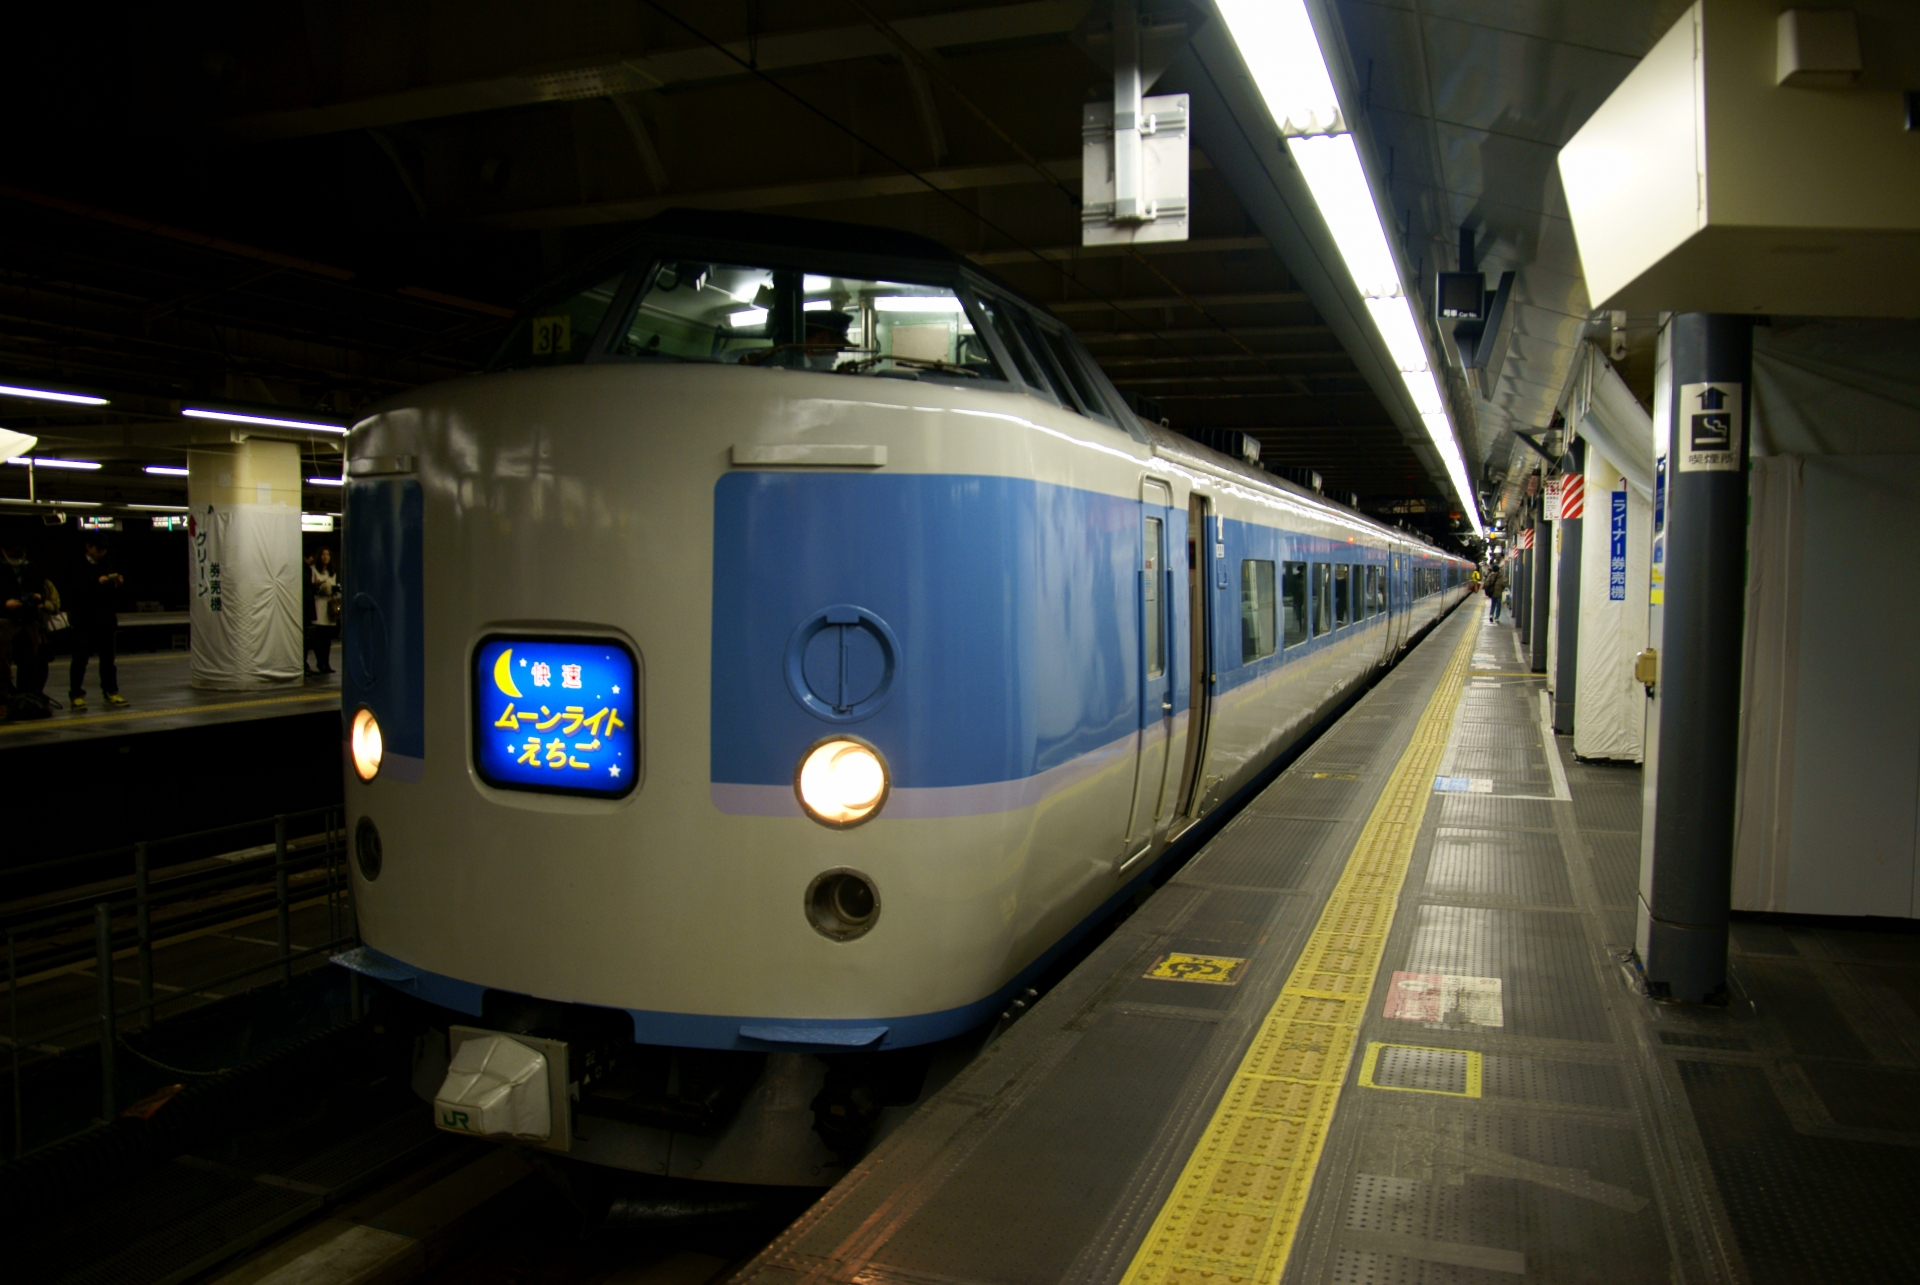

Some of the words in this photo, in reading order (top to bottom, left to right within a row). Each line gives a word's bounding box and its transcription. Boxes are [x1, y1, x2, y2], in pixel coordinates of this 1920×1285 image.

[1688, 452, 1734, 465] 喫煙所
[196, 531, 208, 597] グリーン
[1610, 498, 1626, 600] ライナー券売機
[210, 562, 222, 612] 券売機
[531, 661, 582, 689] 快速
[494, 702, 626, 738] ムーンライト
[517, 736, 601, 769] えちご
[442, 1110, 469, 1130] JR
